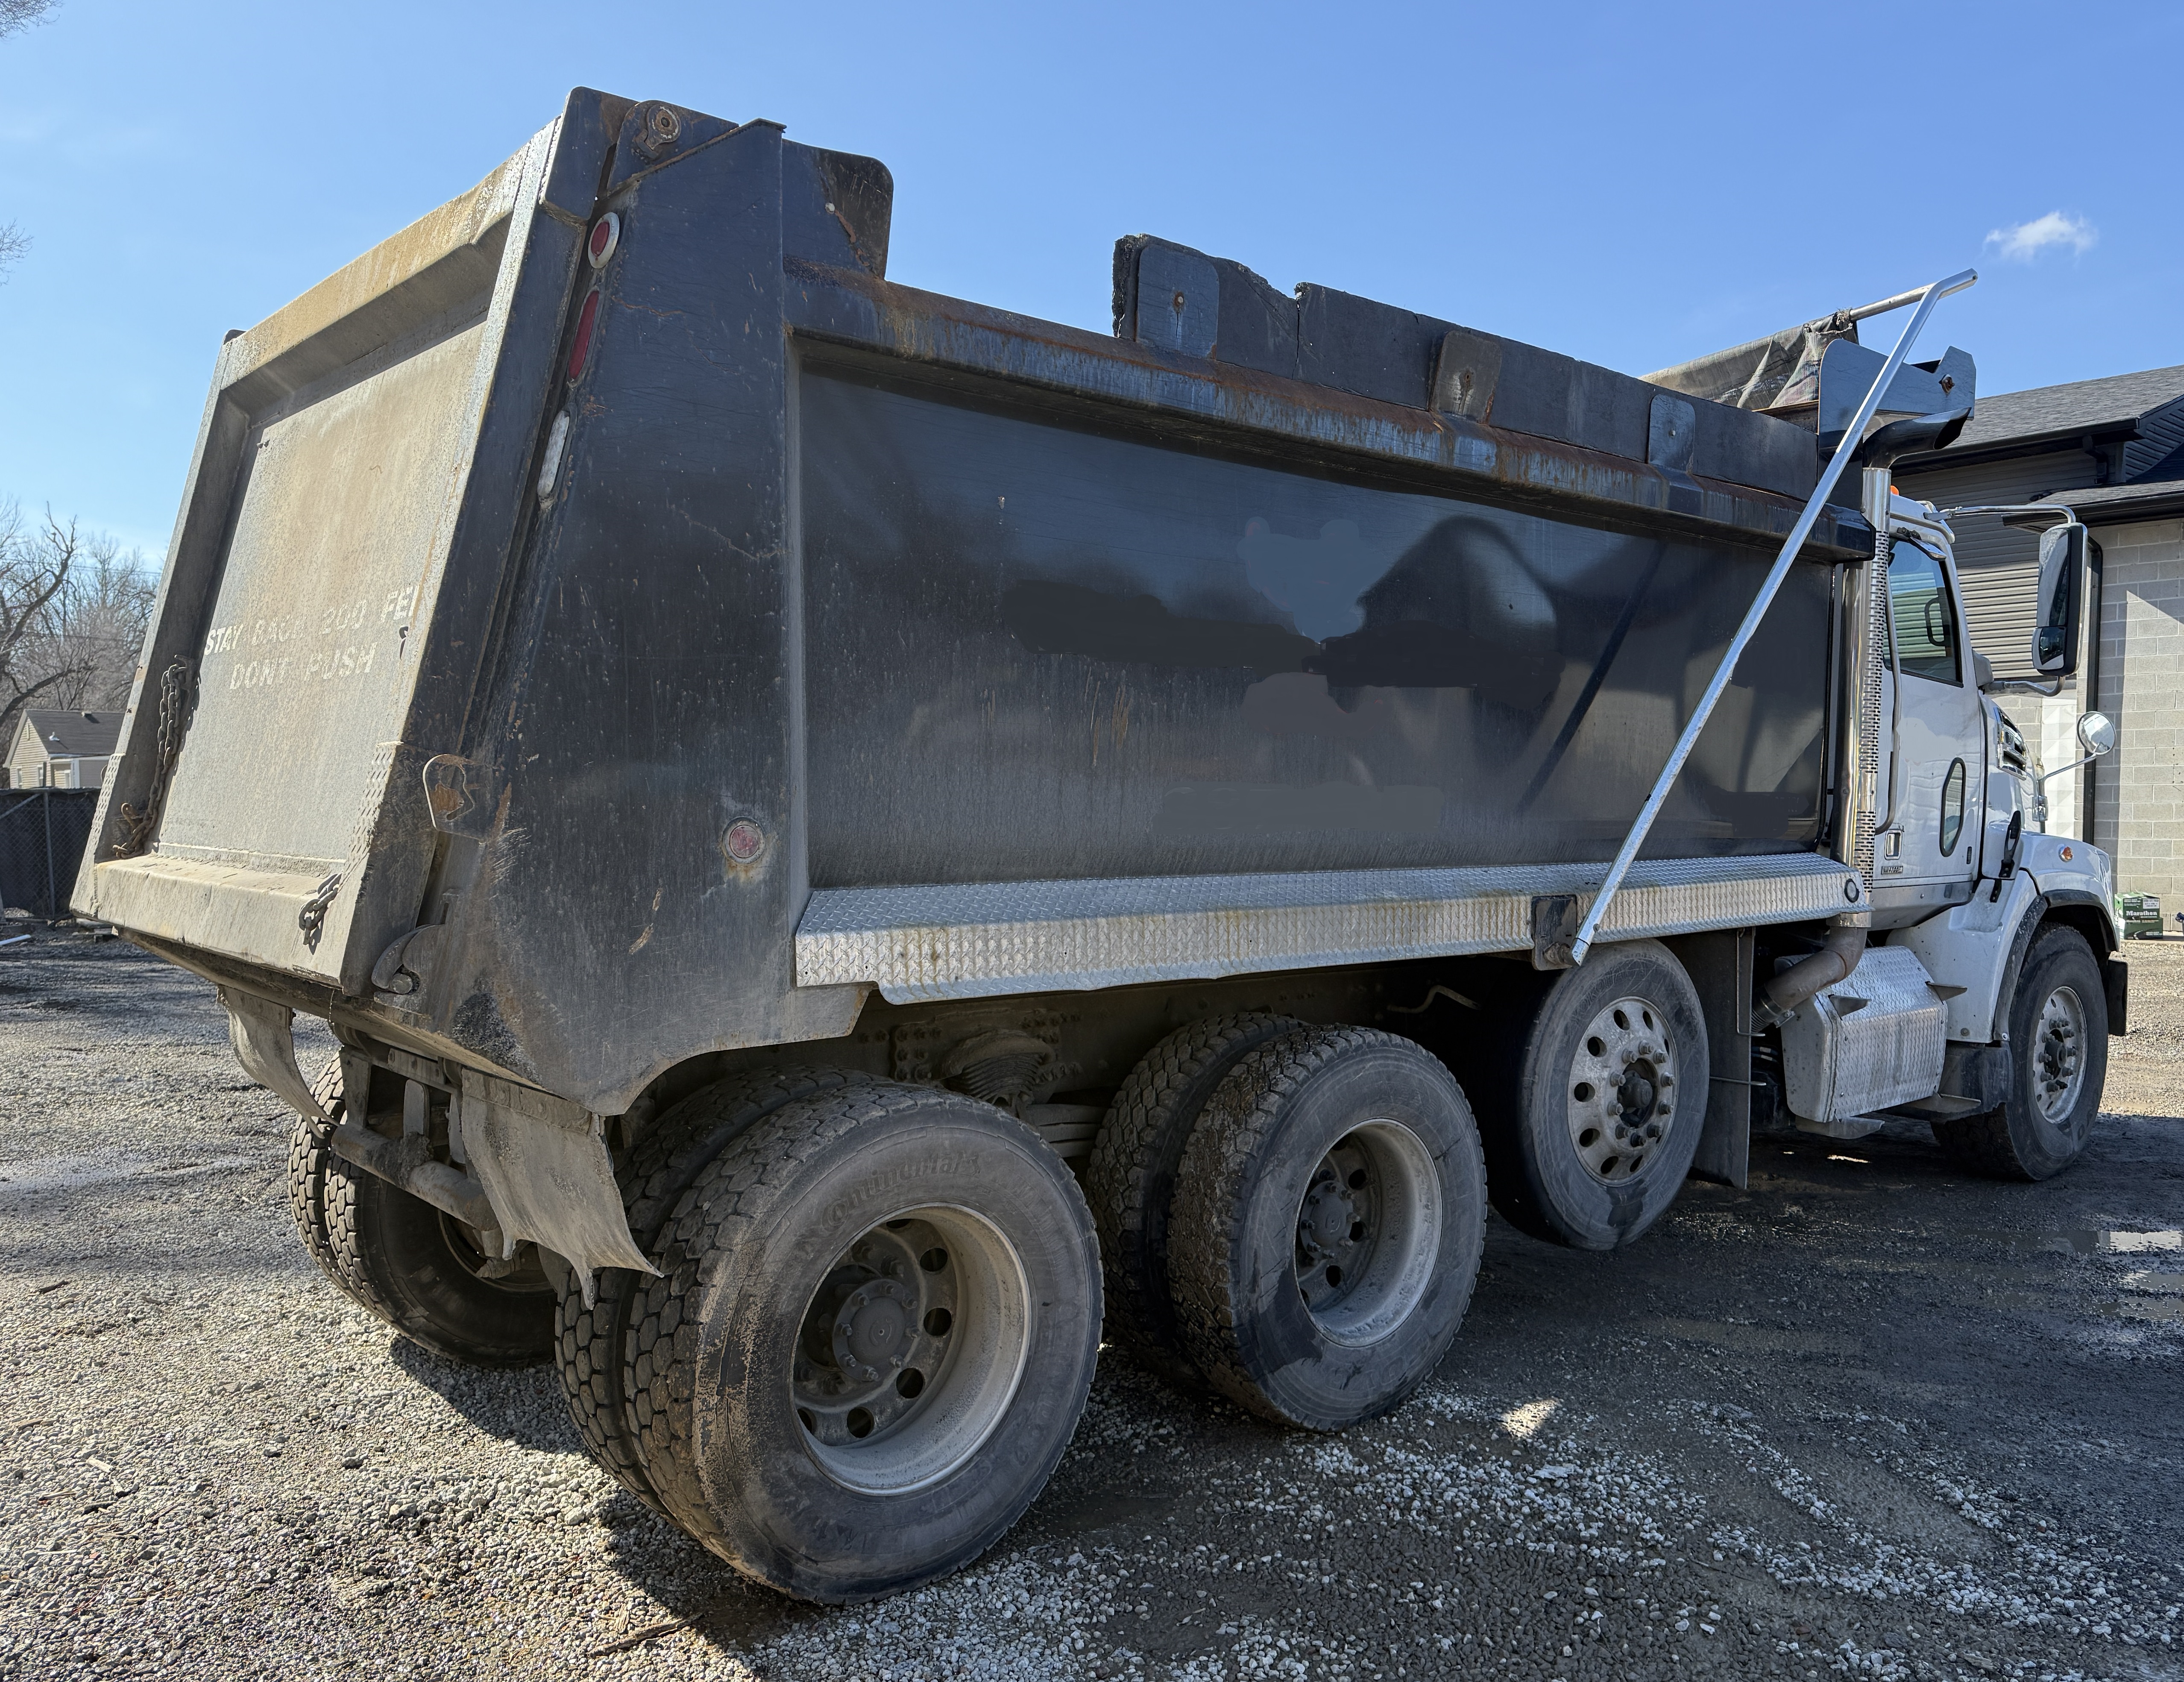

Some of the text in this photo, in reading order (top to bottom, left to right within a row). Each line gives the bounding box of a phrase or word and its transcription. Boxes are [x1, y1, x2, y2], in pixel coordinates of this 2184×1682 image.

[204, 623, 243, 655] STAY
[321, 599, 366, 634] 200
[304, 642, 378, 681] PUSH
[821, 1151, 964, 1232] Continental
